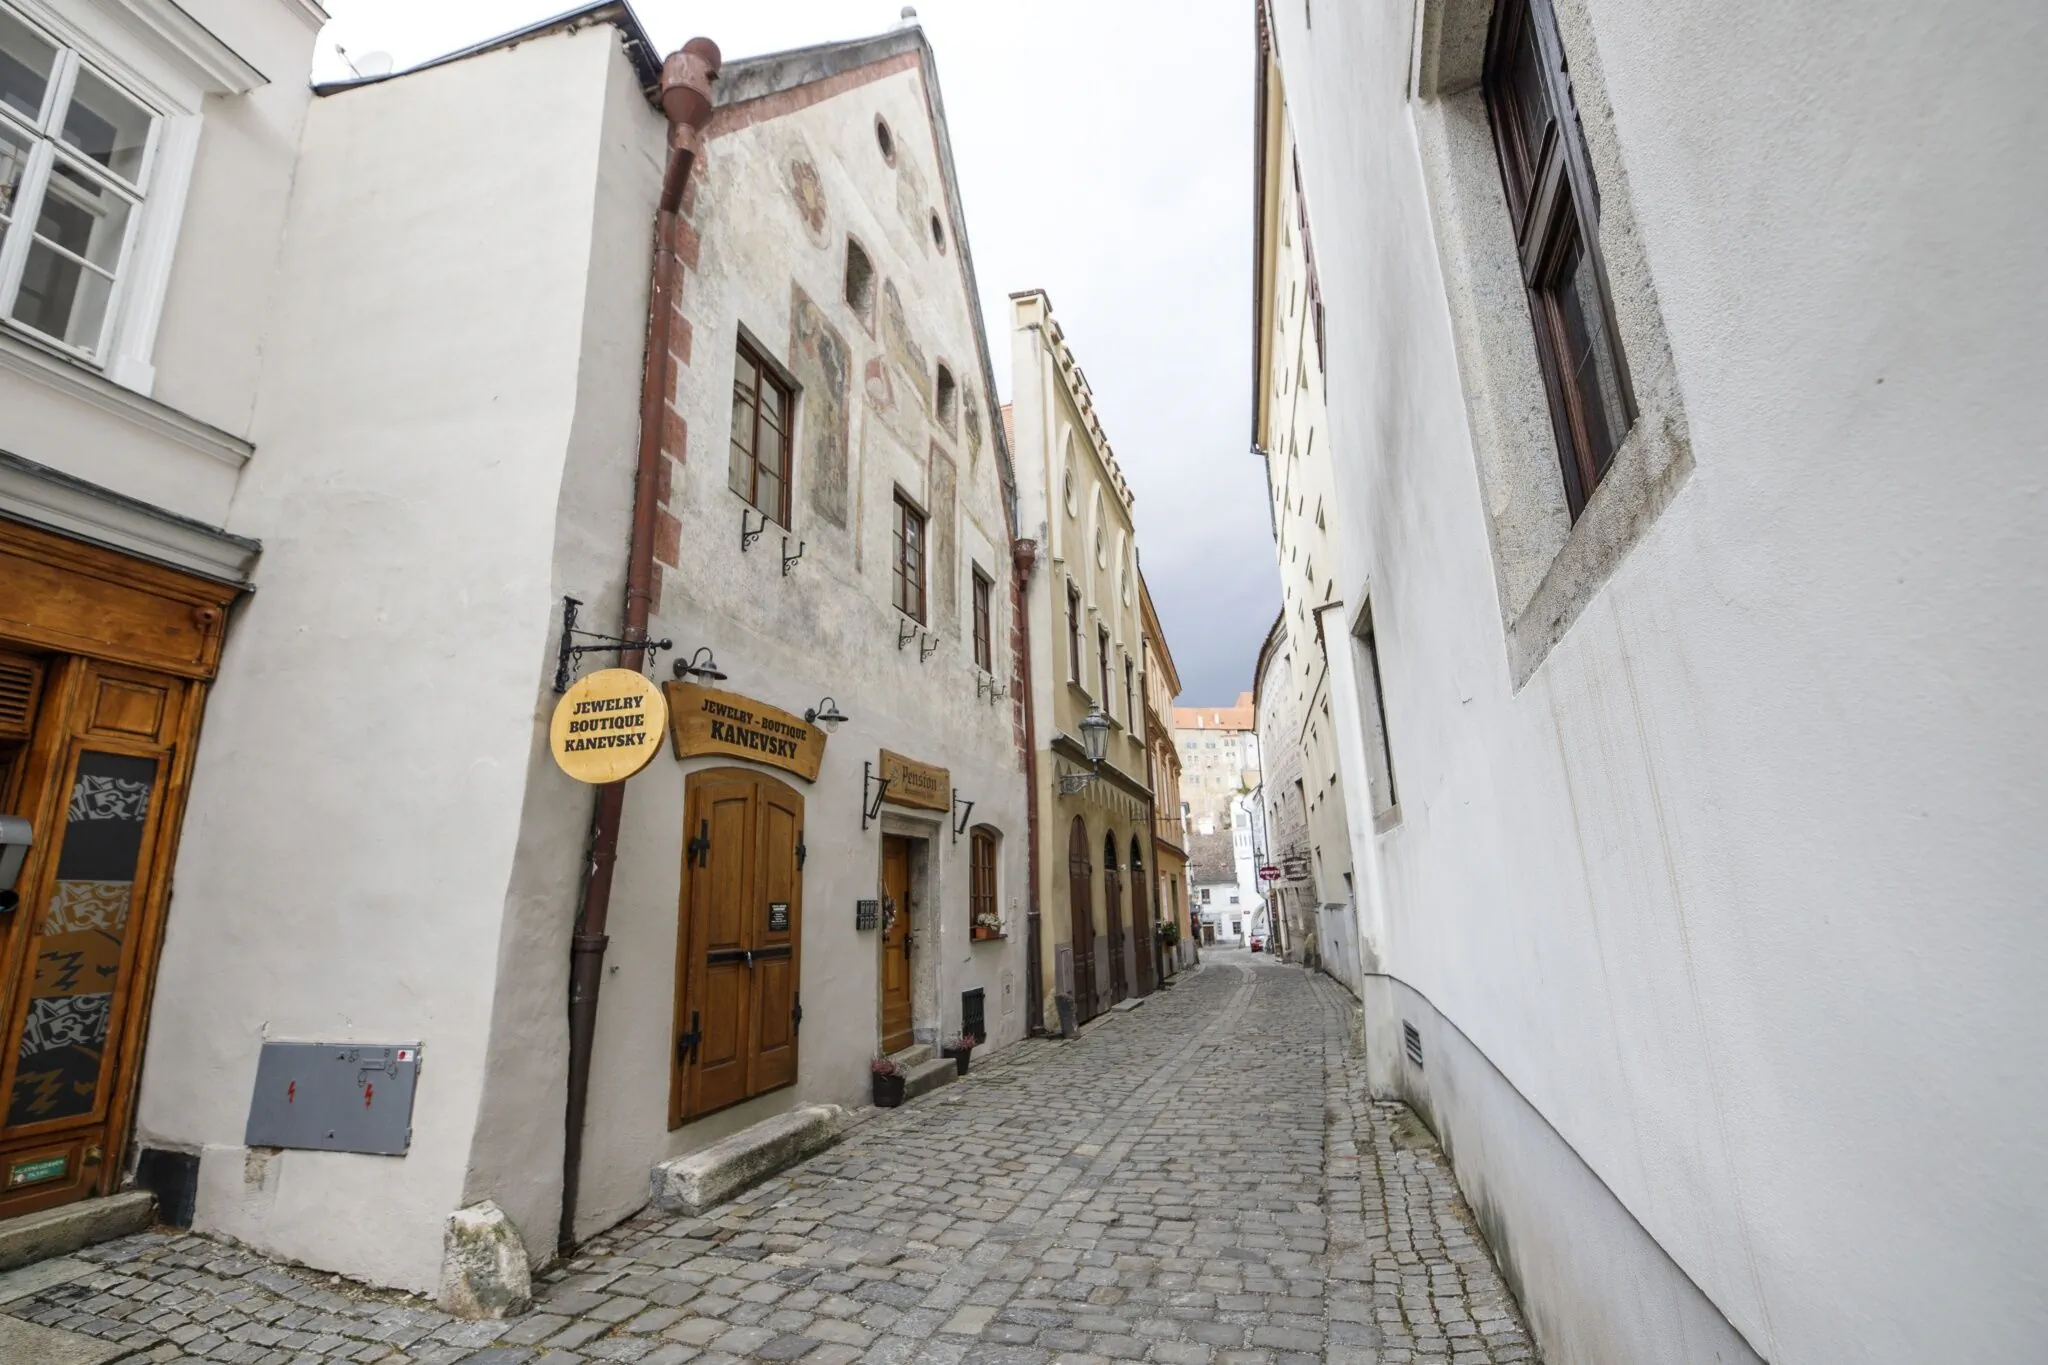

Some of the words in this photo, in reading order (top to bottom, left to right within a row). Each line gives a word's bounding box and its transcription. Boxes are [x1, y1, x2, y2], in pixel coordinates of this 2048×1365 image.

[573, 696, 643, 715] JEWELRY
[569, 715, 644, 733] BOUTIQUE
[701, 699, 753, 724] JEWELRY
[762, 718, 807, 741] BOUTIQUE
[564, 733, 646, 752] KANEVSKY
[711, 721, 798, 759] KANEVSKY
[902, 765, 937, 791] Pension
